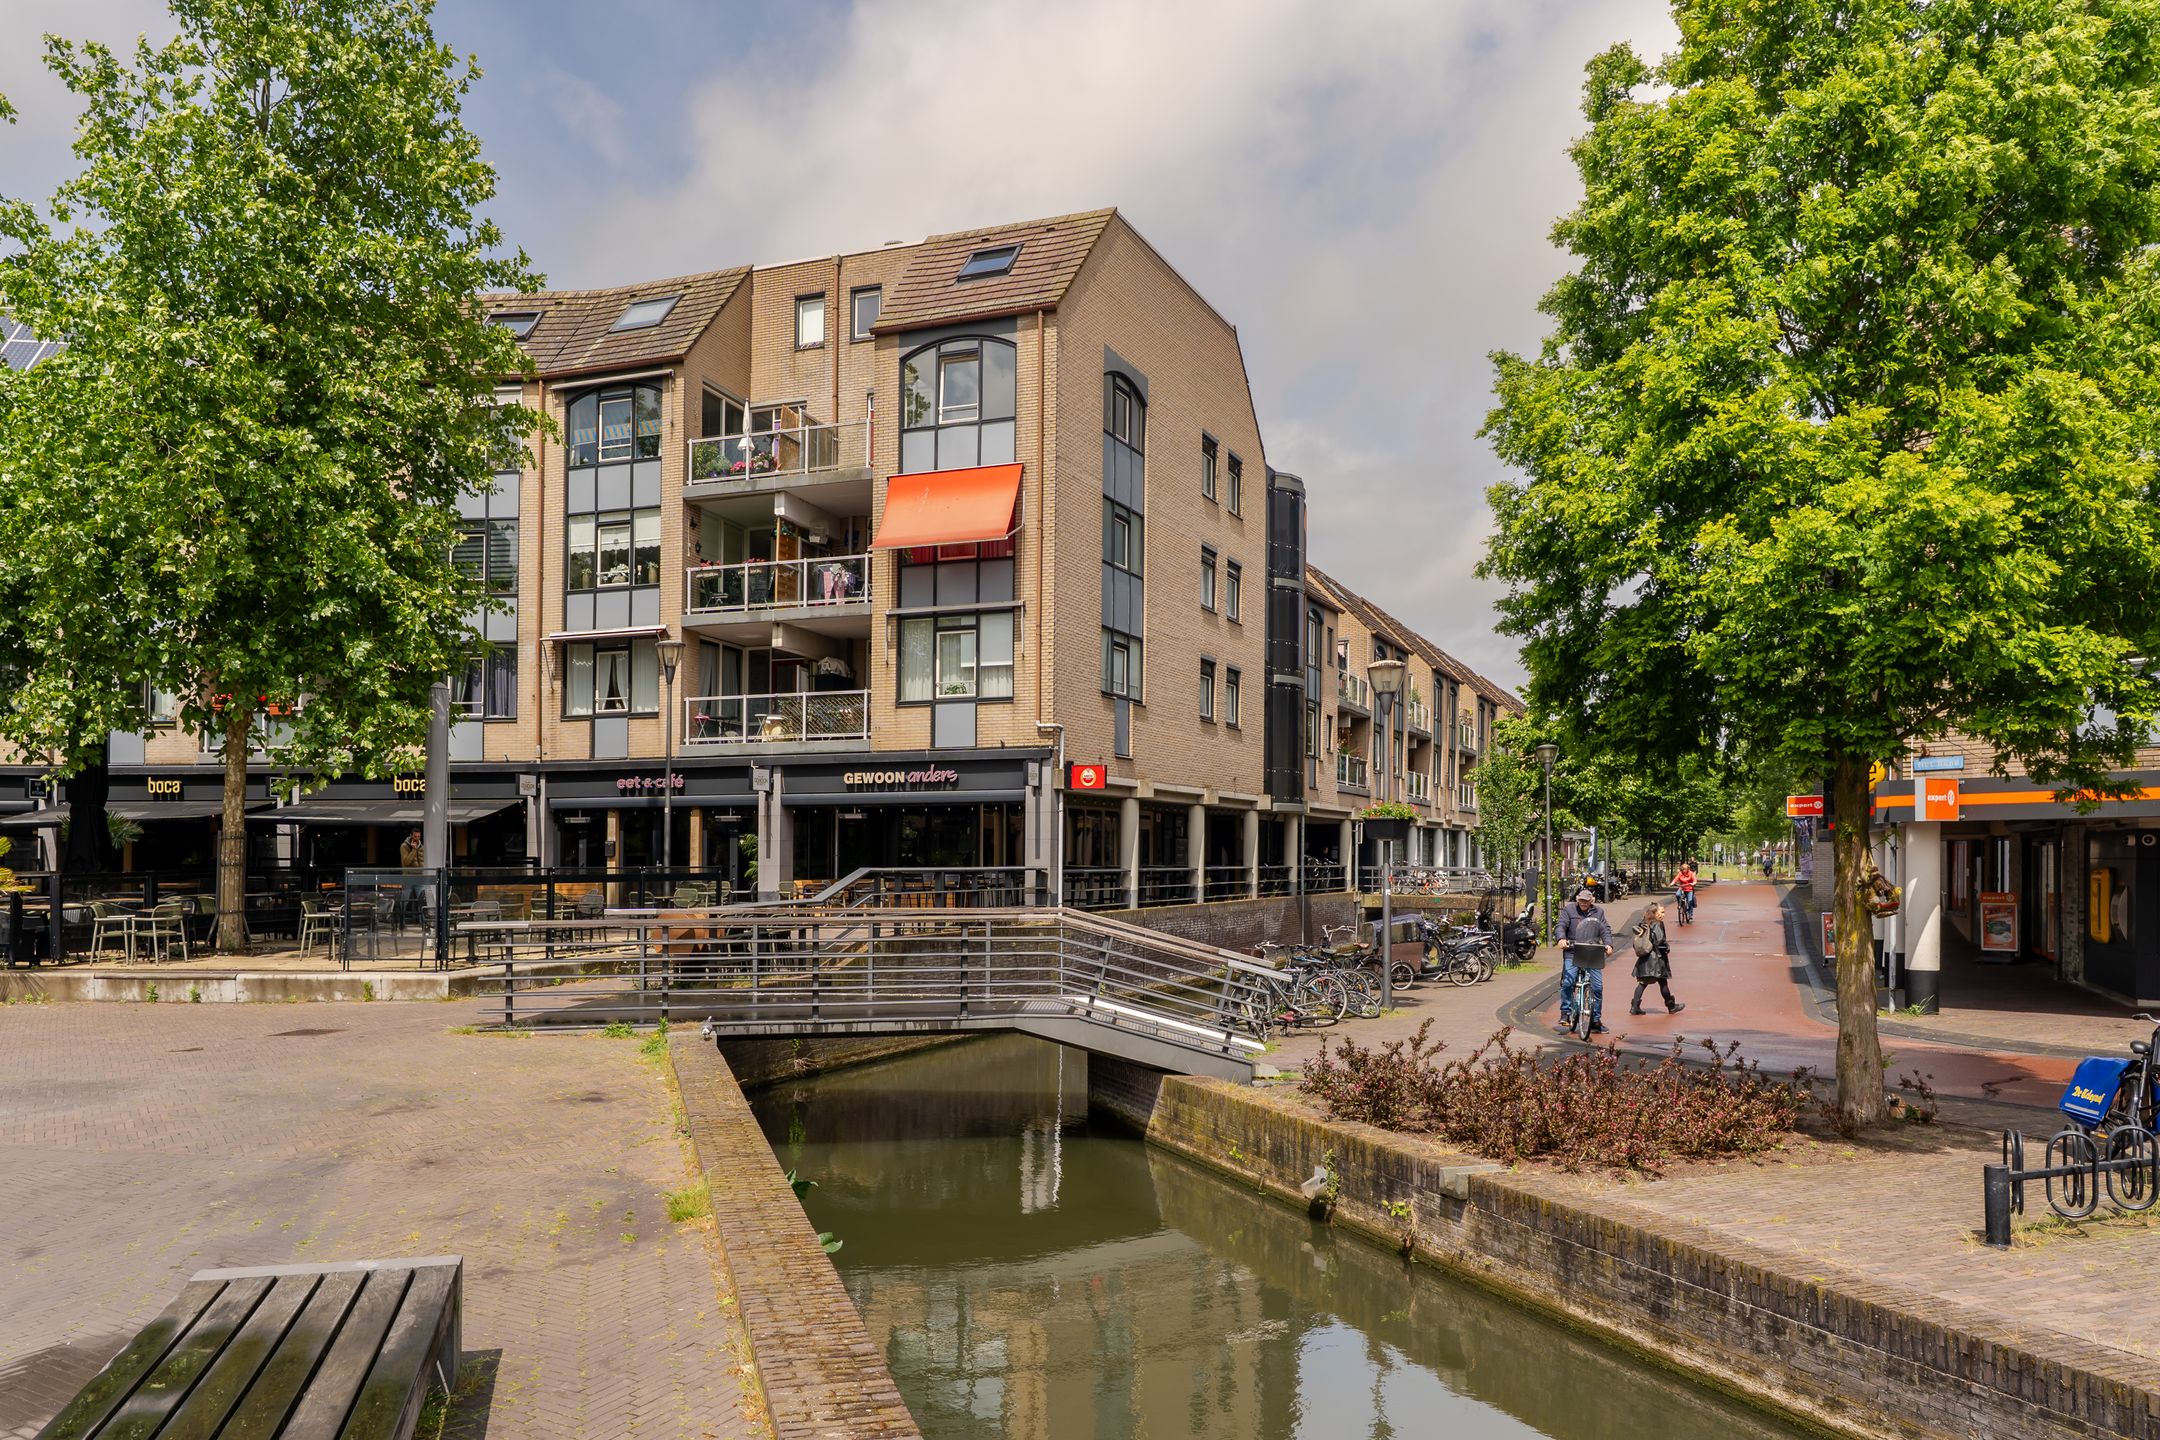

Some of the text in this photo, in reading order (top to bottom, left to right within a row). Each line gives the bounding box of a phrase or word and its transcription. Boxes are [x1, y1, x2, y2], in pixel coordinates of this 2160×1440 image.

[616, 776, 641, 789] eet
[655, 773, 684, 788] café
[843, 764, 958, 784] GEWOON anders
[147, 776, 182, 793] boca
[393, 775, 425, 792] boca
[1927, 794, 1947, 803] expert
